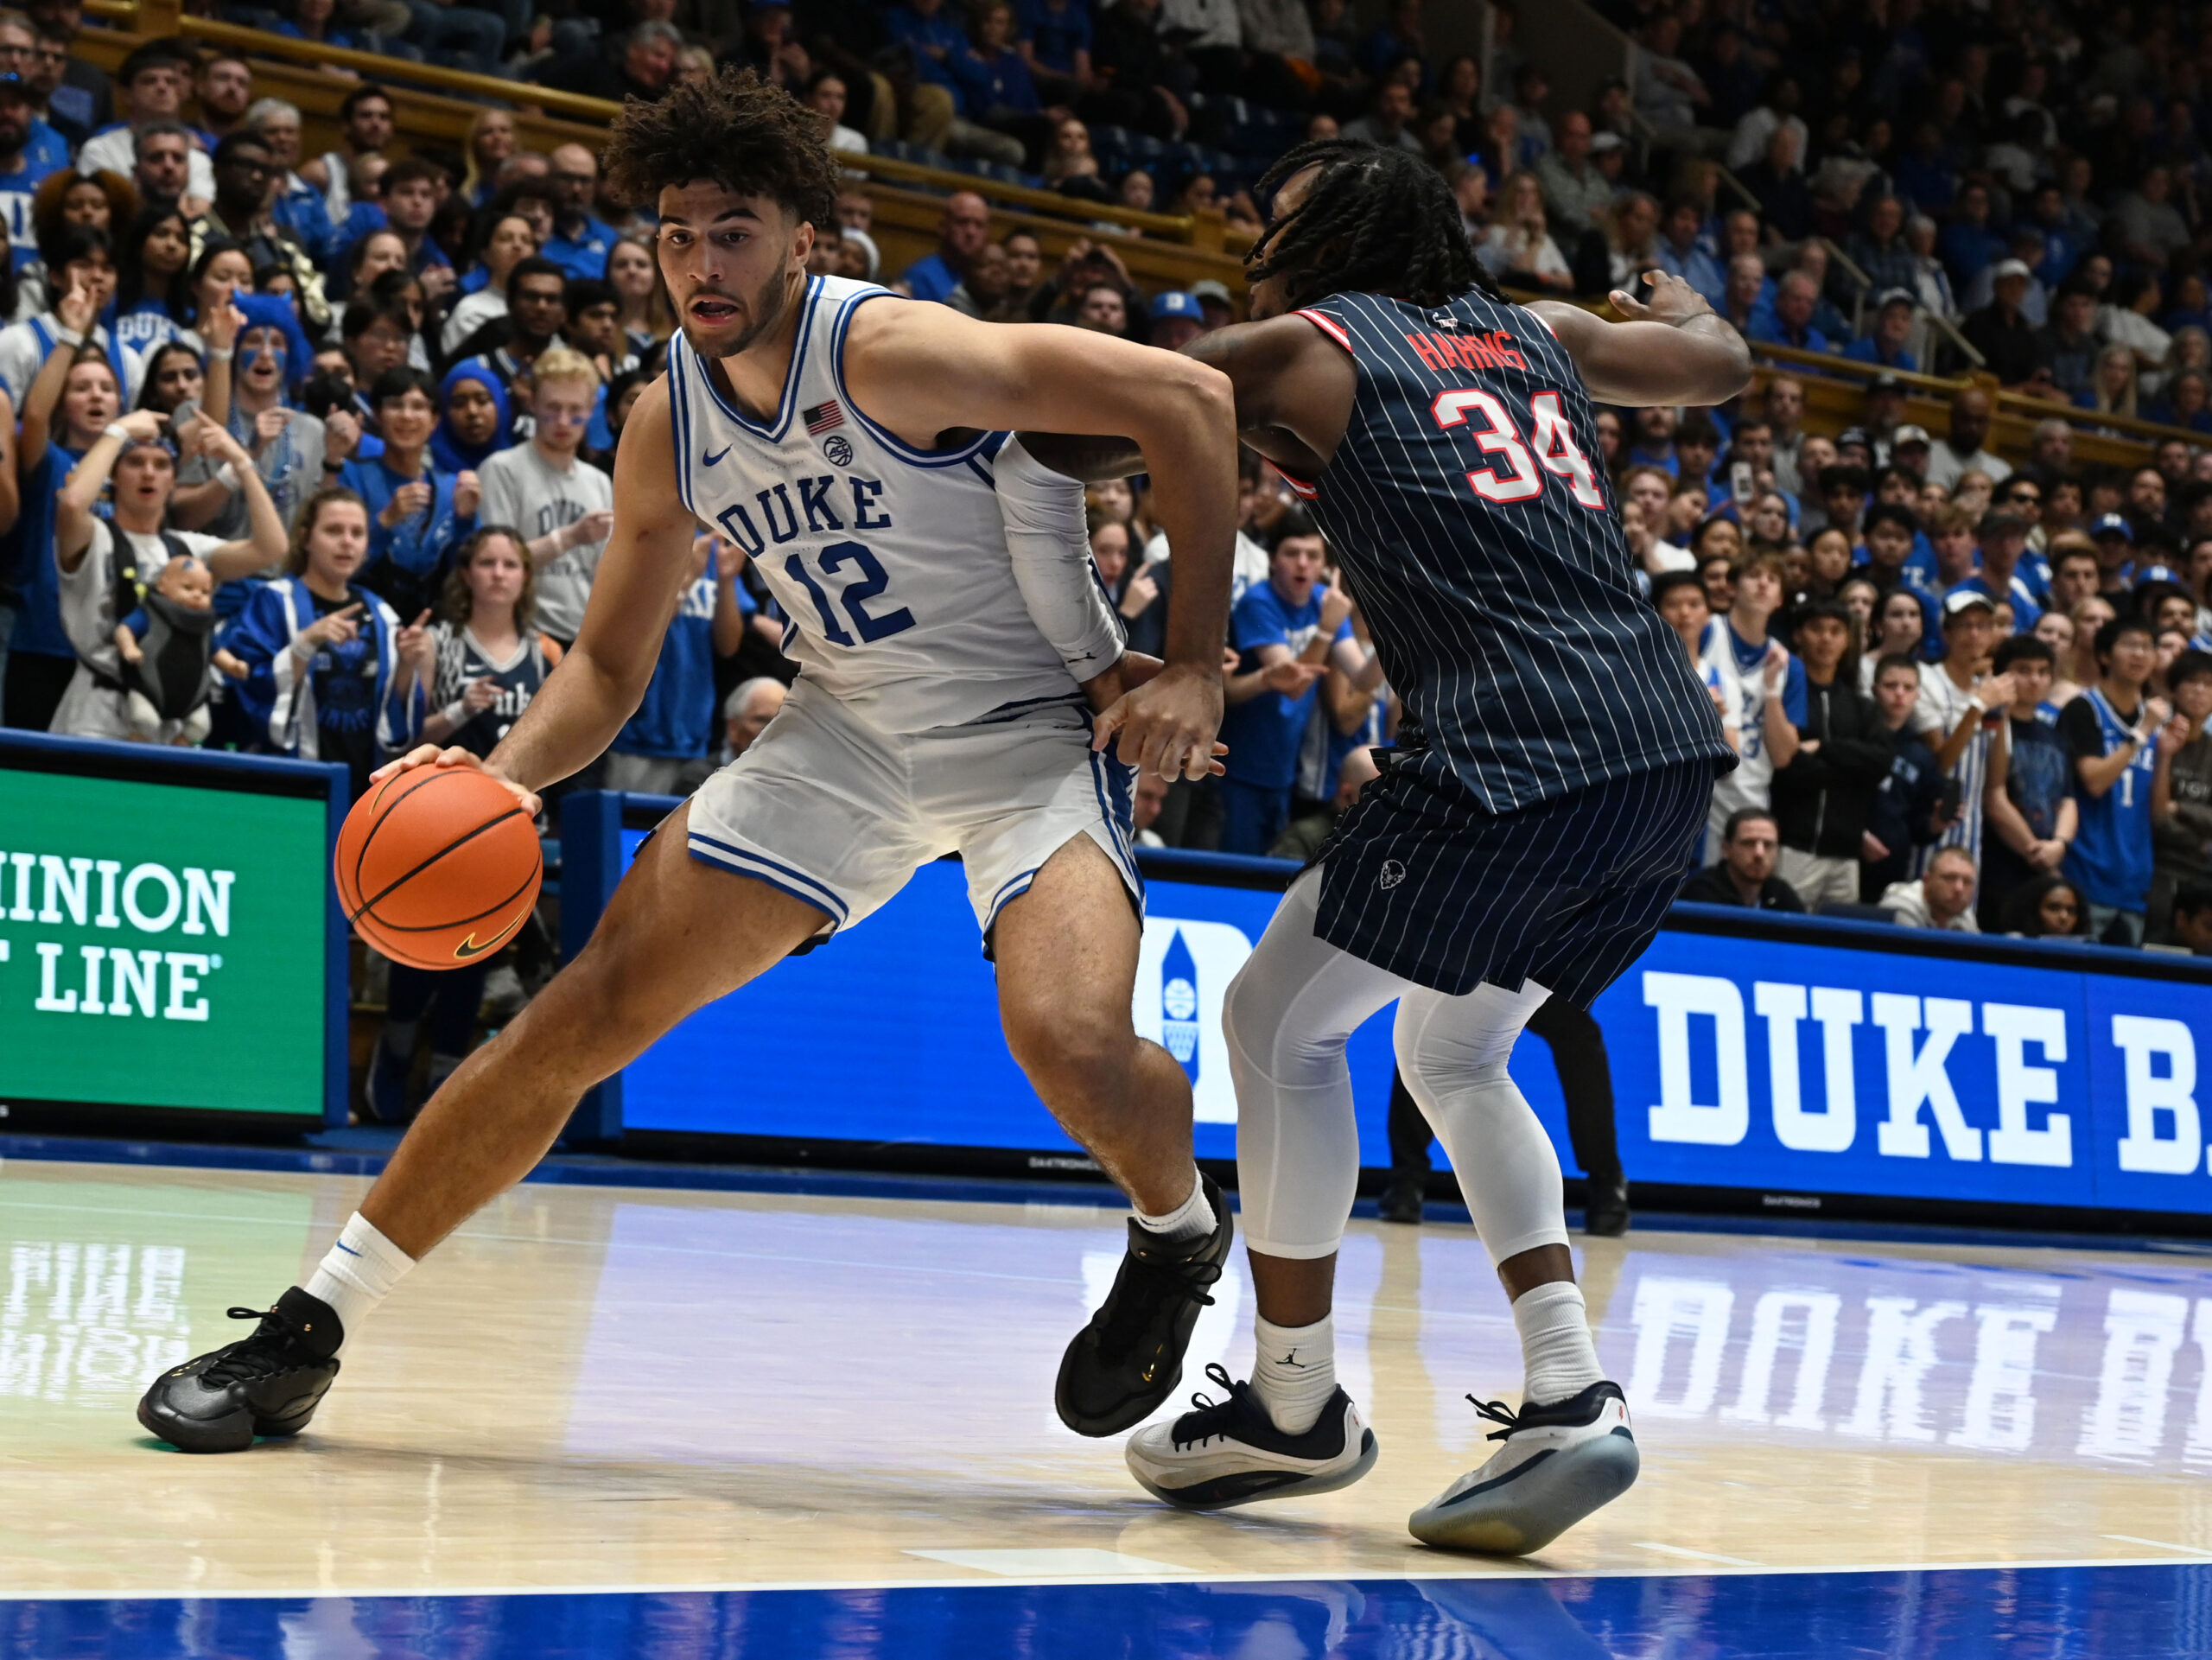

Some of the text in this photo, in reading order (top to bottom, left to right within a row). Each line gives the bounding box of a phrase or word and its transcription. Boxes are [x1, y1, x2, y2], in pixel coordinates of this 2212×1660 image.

[1406, 330, 1527, 371] HARRIS
[1431, 388, 1605, 510] 34
[717, 474, 892, 558] DUKE
[785, 541, 917, 647] 12
[0, 851, 235, 937] INION
[1643, 970, 2212, 1176] DUKE B
